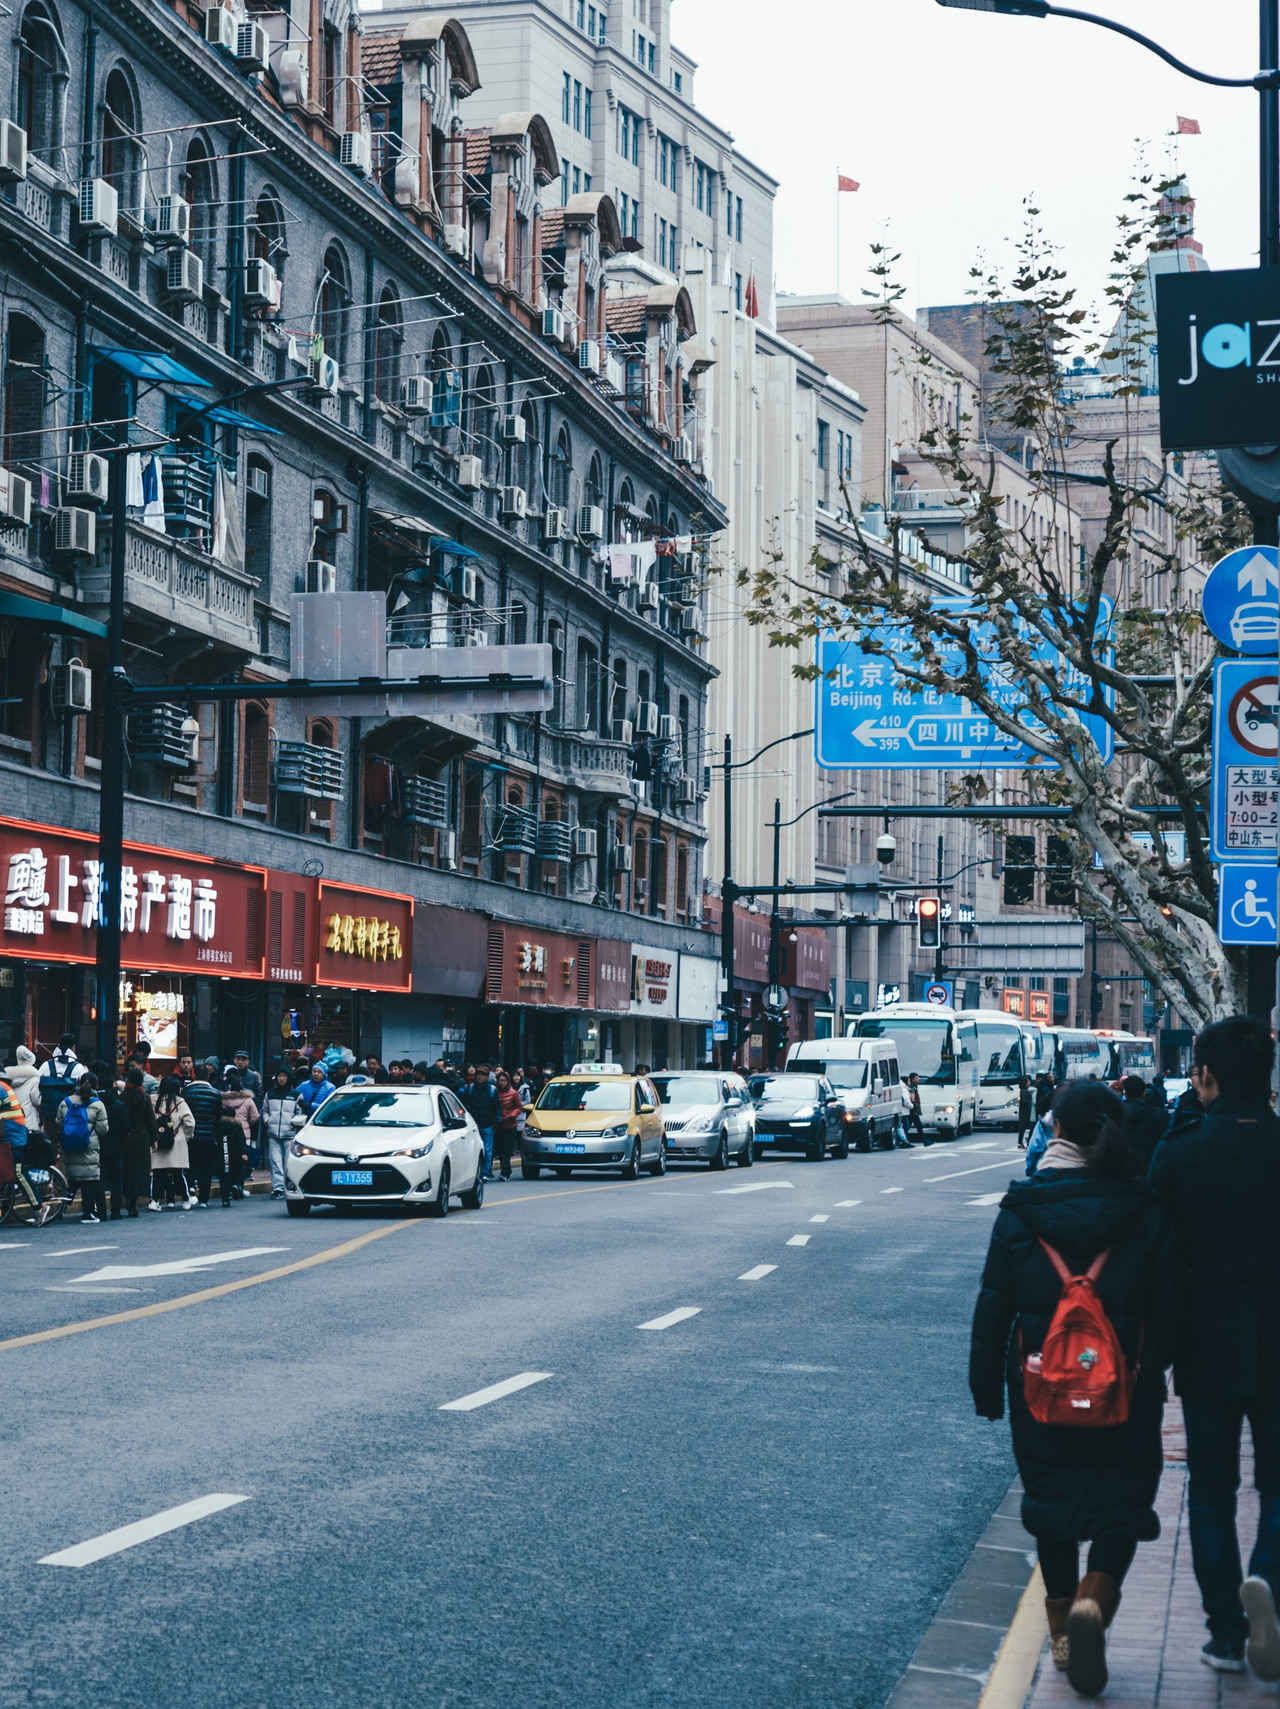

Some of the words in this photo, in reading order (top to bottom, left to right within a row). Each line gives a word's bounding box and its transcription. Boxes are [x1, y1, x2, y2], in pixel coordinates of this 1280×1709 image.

[830, 691, 882, 710] Beijing
[892, 691, 917, 706] Rd.
[879, 715, 901, 728] 410
[879, 738, 900, 750] 395
